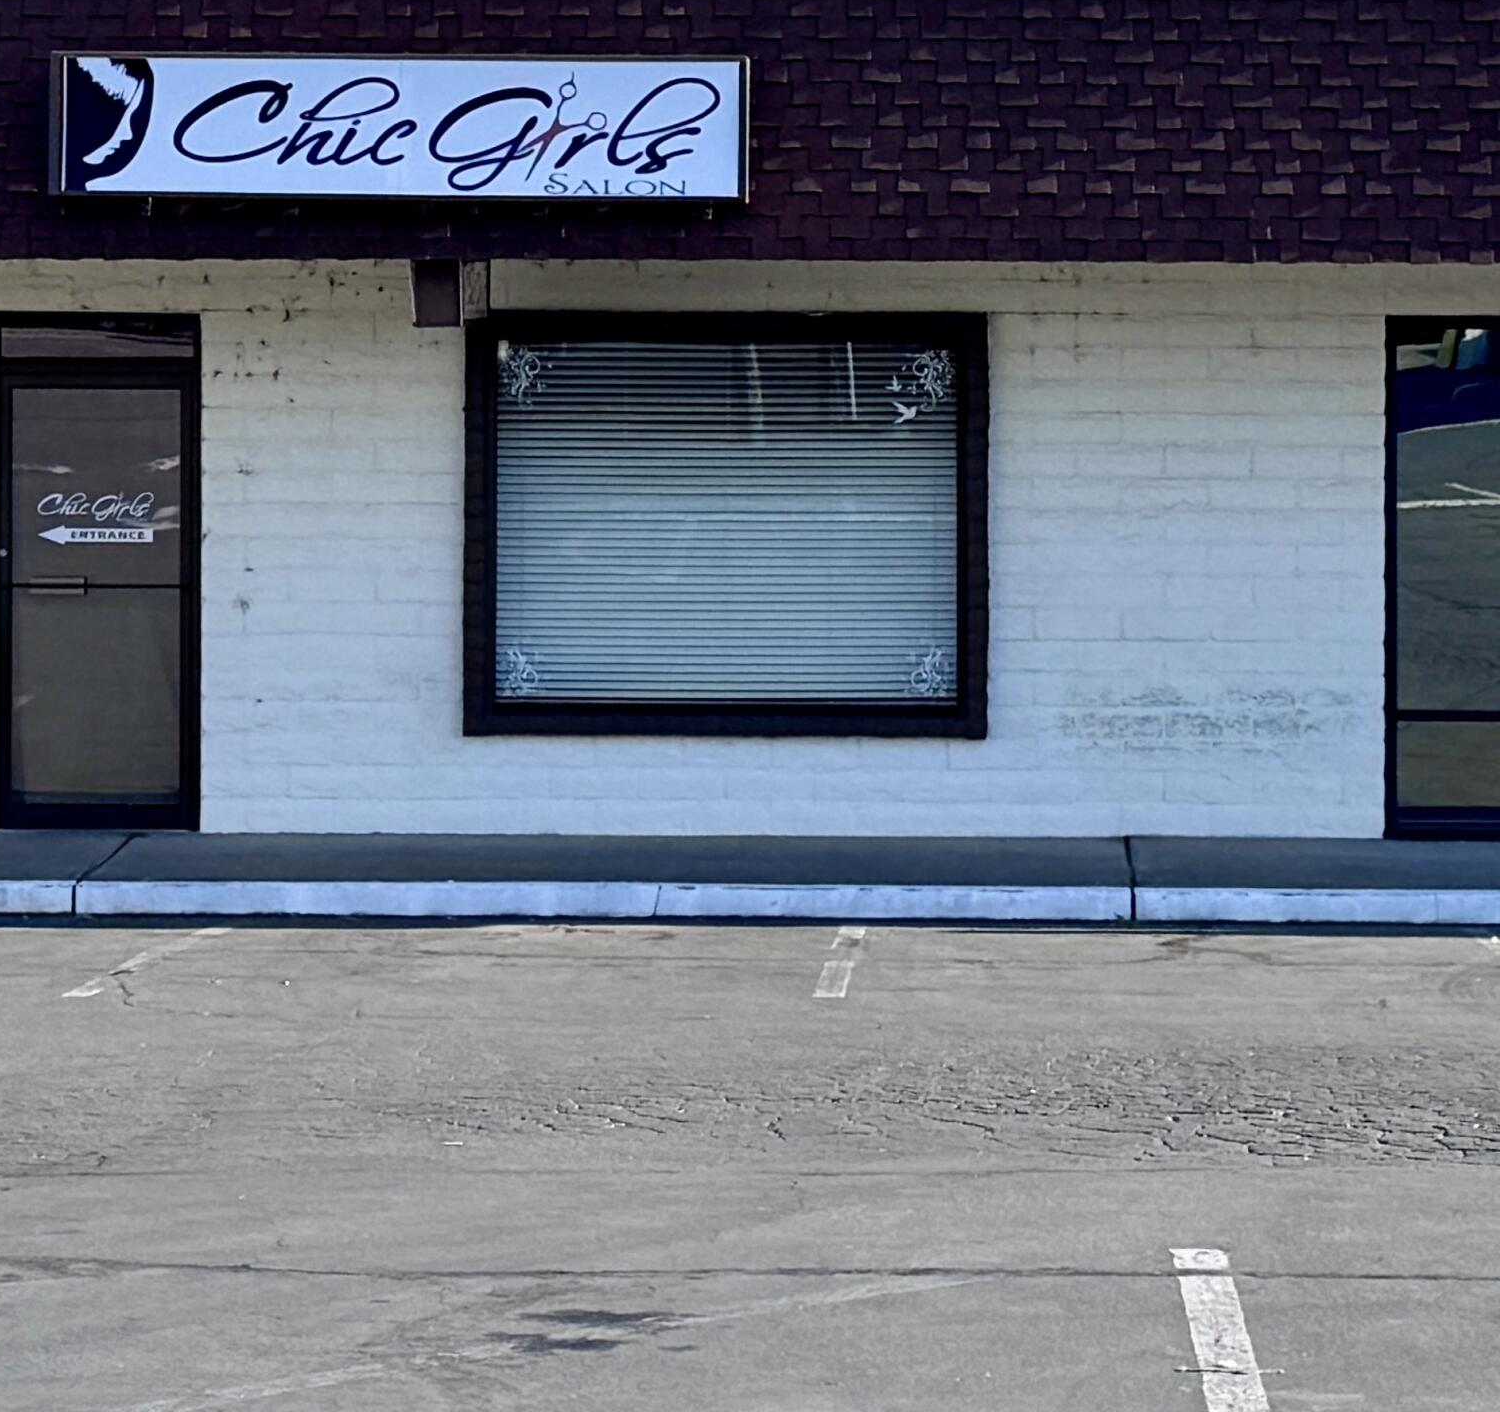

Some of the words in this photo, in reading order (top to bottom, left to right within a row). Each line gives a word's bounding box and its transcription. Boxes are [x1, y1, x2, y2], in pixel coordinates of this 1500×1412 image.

[173, 76, 417, 166] Chic
[428, 72, 721, 191] Girls
[543, 172, 687, 195] SALON
[37, 493, 90, 515] Chic
[91, 492, 155, 521] Girls
[70, 531, 146, 540] ENTRANCE
